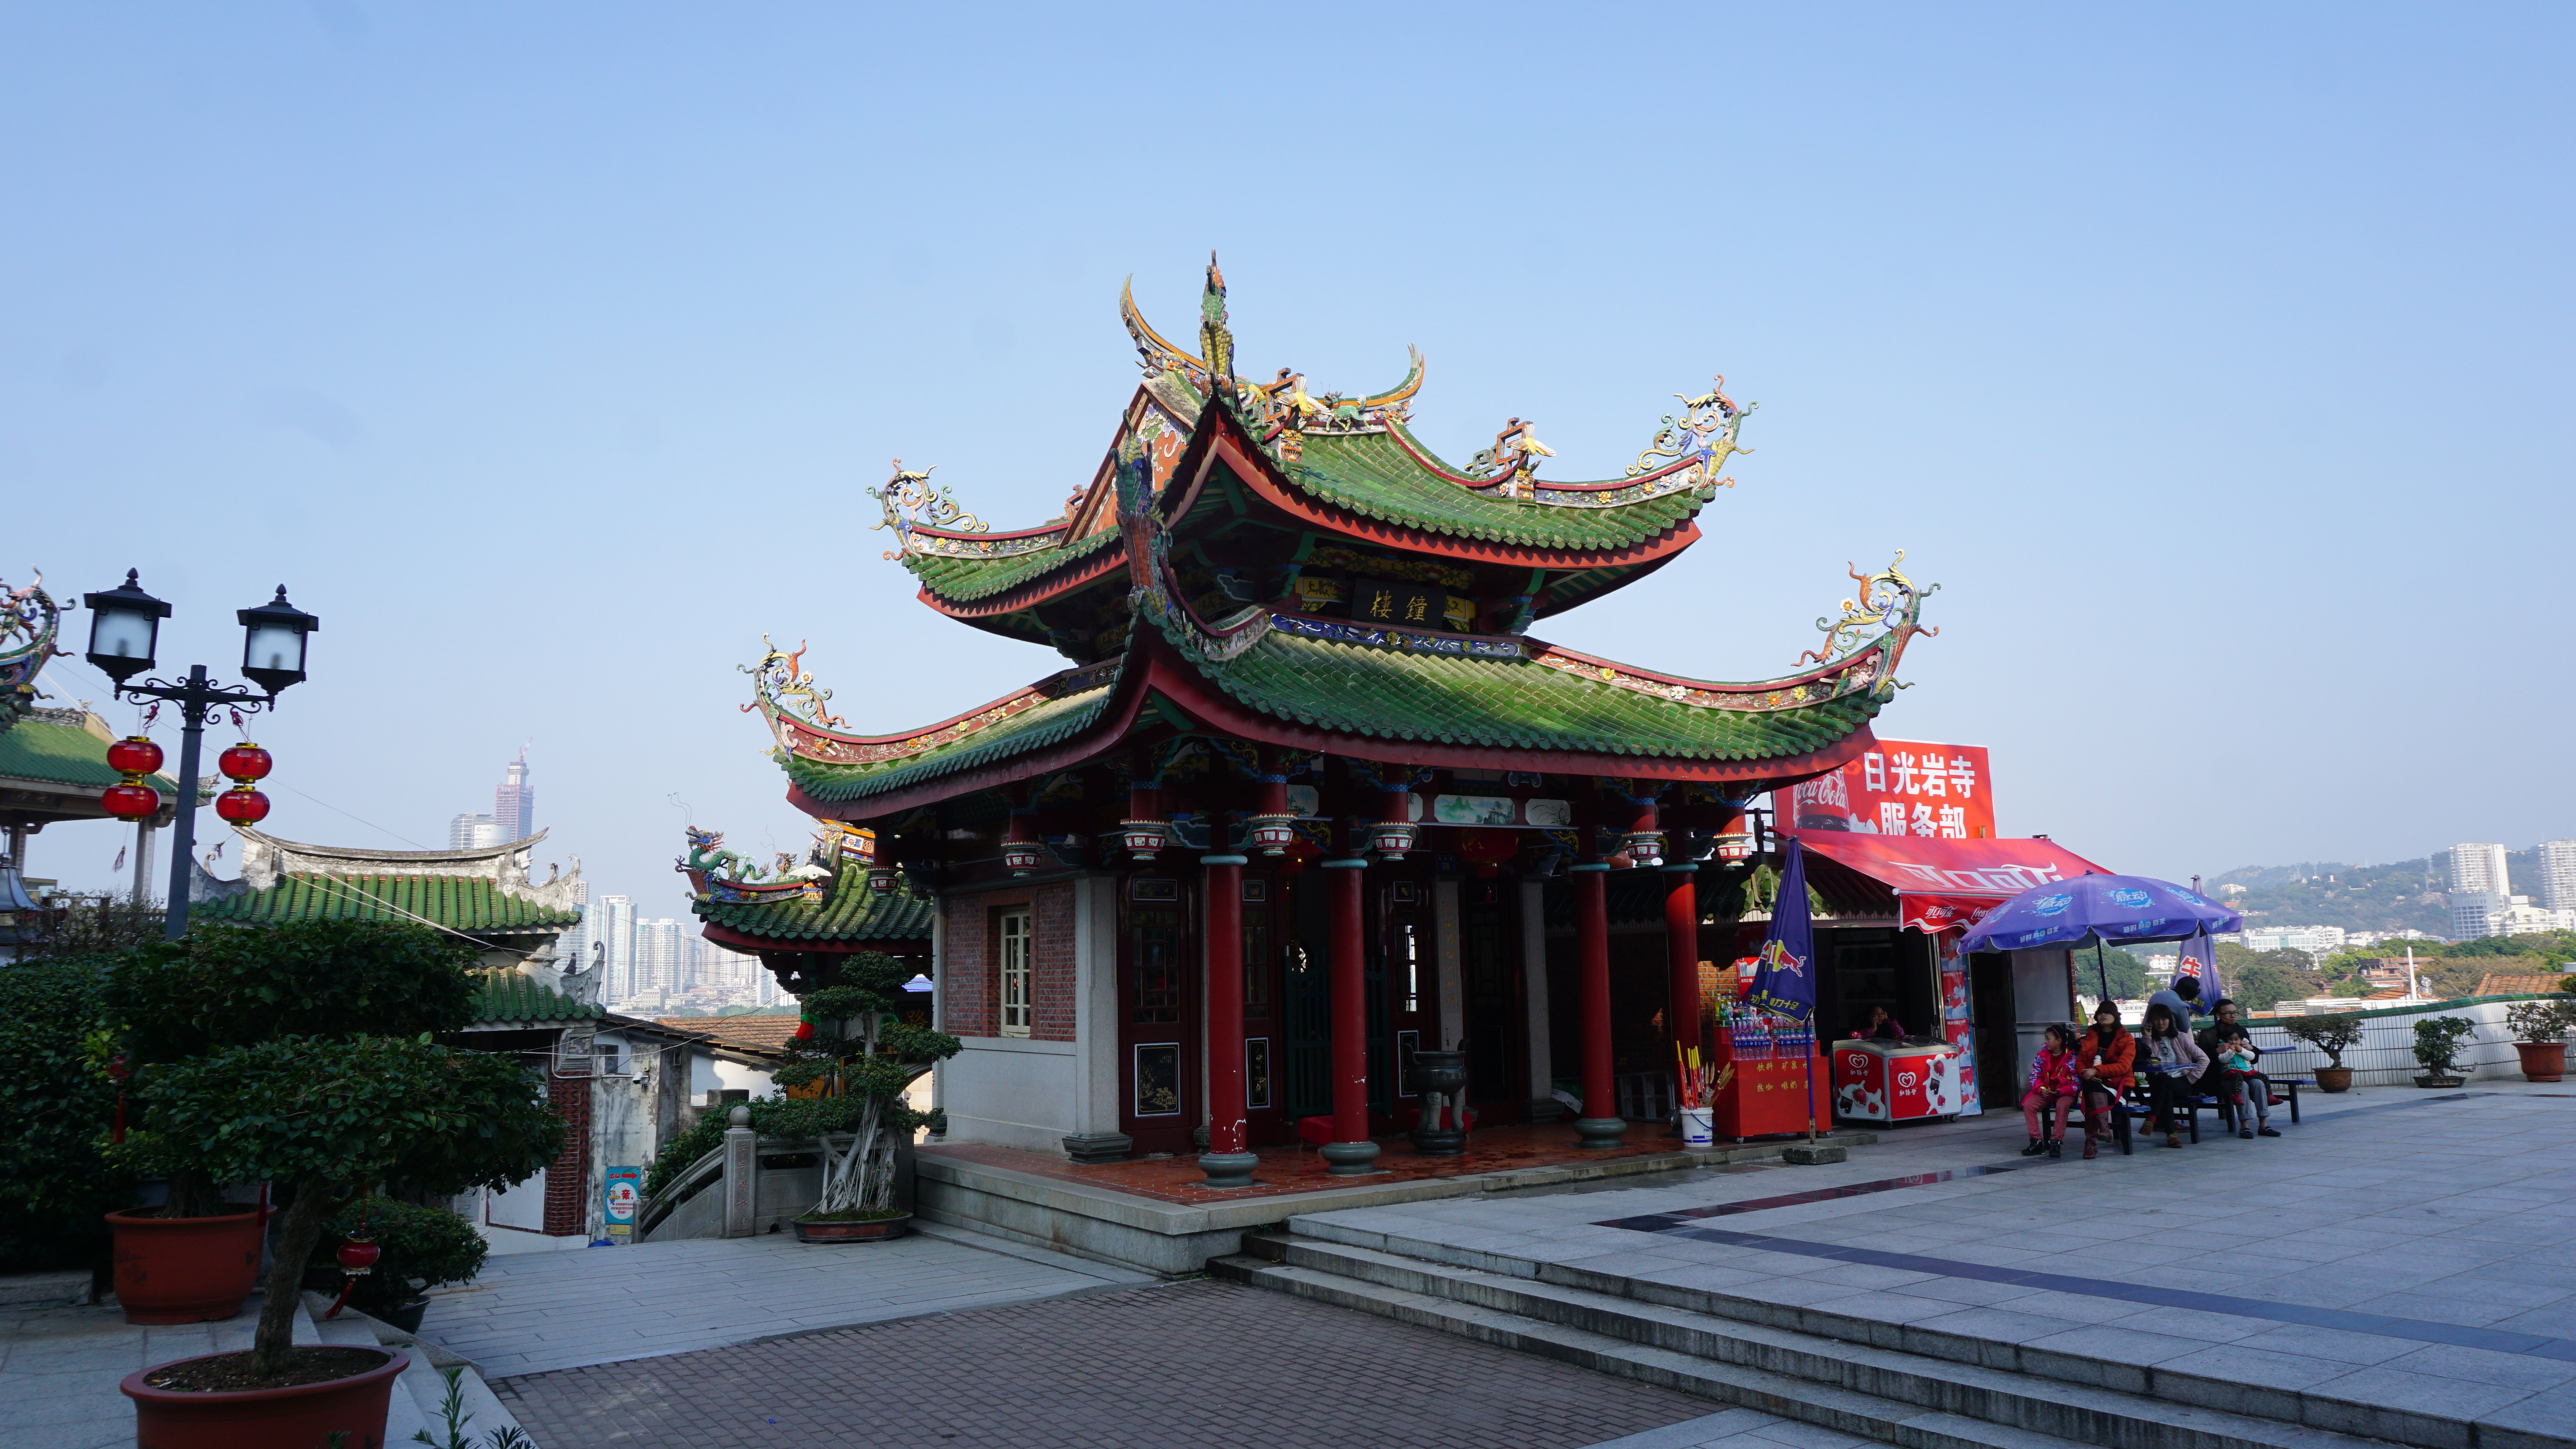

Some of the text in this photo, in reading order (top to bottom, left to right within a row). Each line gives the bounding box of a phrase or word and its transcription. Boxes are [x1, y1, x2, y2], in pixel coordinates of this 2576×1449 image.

[1864, 752, 1975, 798] 日光岩寺
[1880, 802, 1967, 838] 服务部
[2115, 890, 2148, 903] 脉动
[2180, 955, 2202, 978] 牛
